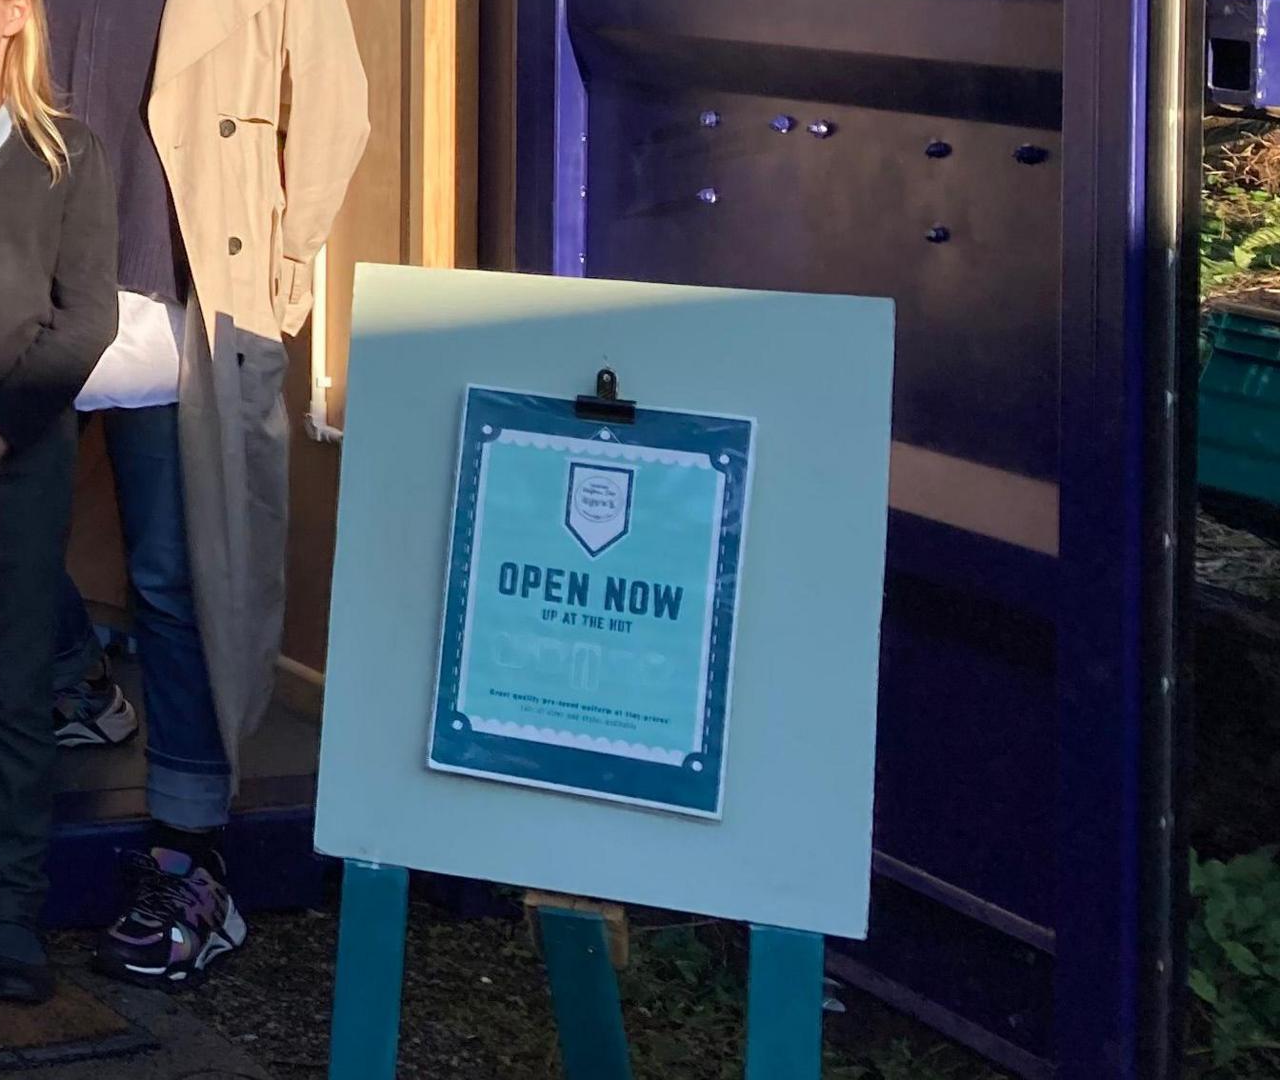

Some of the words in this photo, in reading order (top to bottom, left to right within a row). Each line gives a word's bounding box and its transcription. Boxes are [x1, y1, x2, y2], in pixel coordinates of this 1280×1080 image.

[498, 561, 590, 608] OPEN
[604, 575, 684, 621] NOW
[542, 608, 558, 622] UP
[562, 612, 578, 626] AT
[582, 614, 605, 631] THE
[609, 618, 633, 634] HUT
